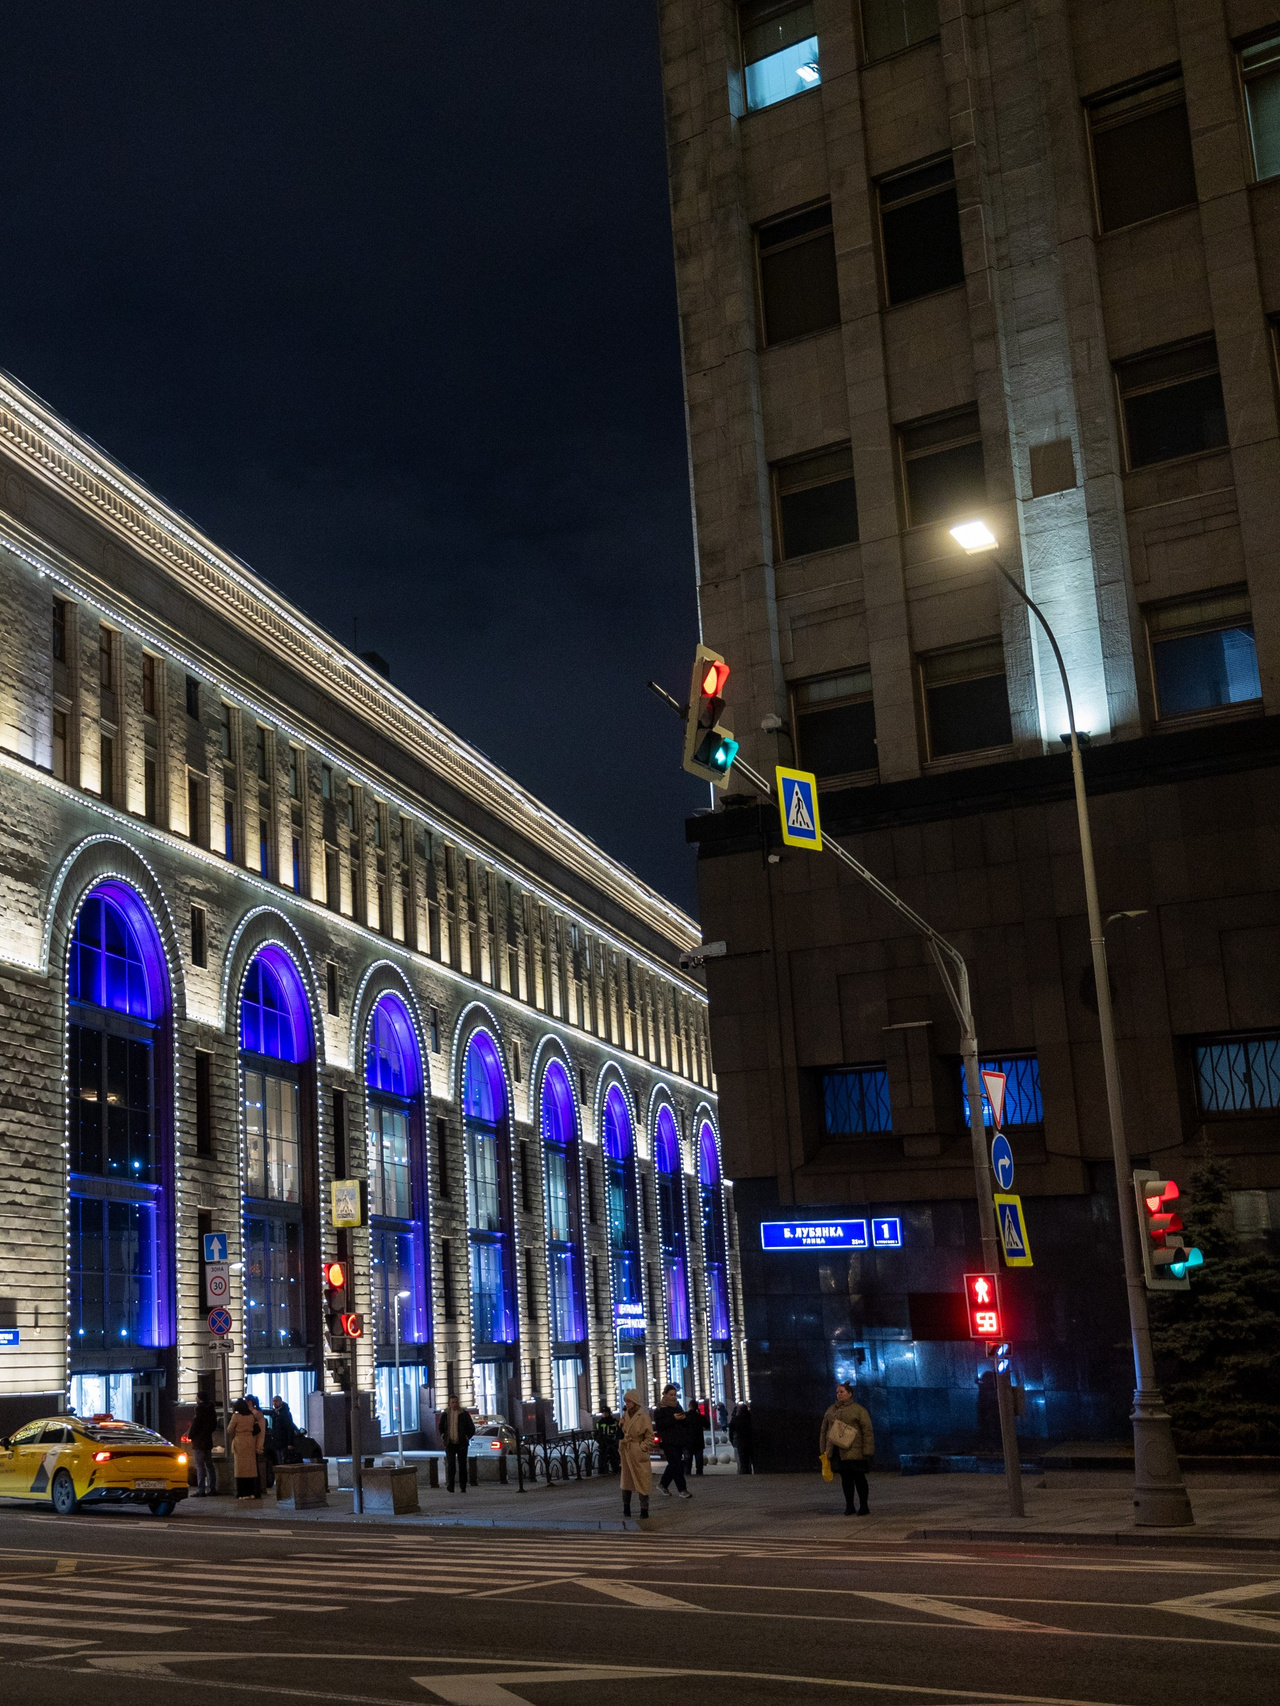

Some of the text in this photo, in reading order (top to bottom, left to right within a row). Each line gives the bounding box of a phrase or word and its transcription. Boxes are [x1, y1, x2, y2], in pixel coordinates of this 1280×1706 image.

[784, 1226, 844, 1238] Б. ЛУБЯНКА
[881, 1223, 890, 1239] 1
[213, 1281, 224, 1291] 30
[976, 1312, 997, 1331] 58
